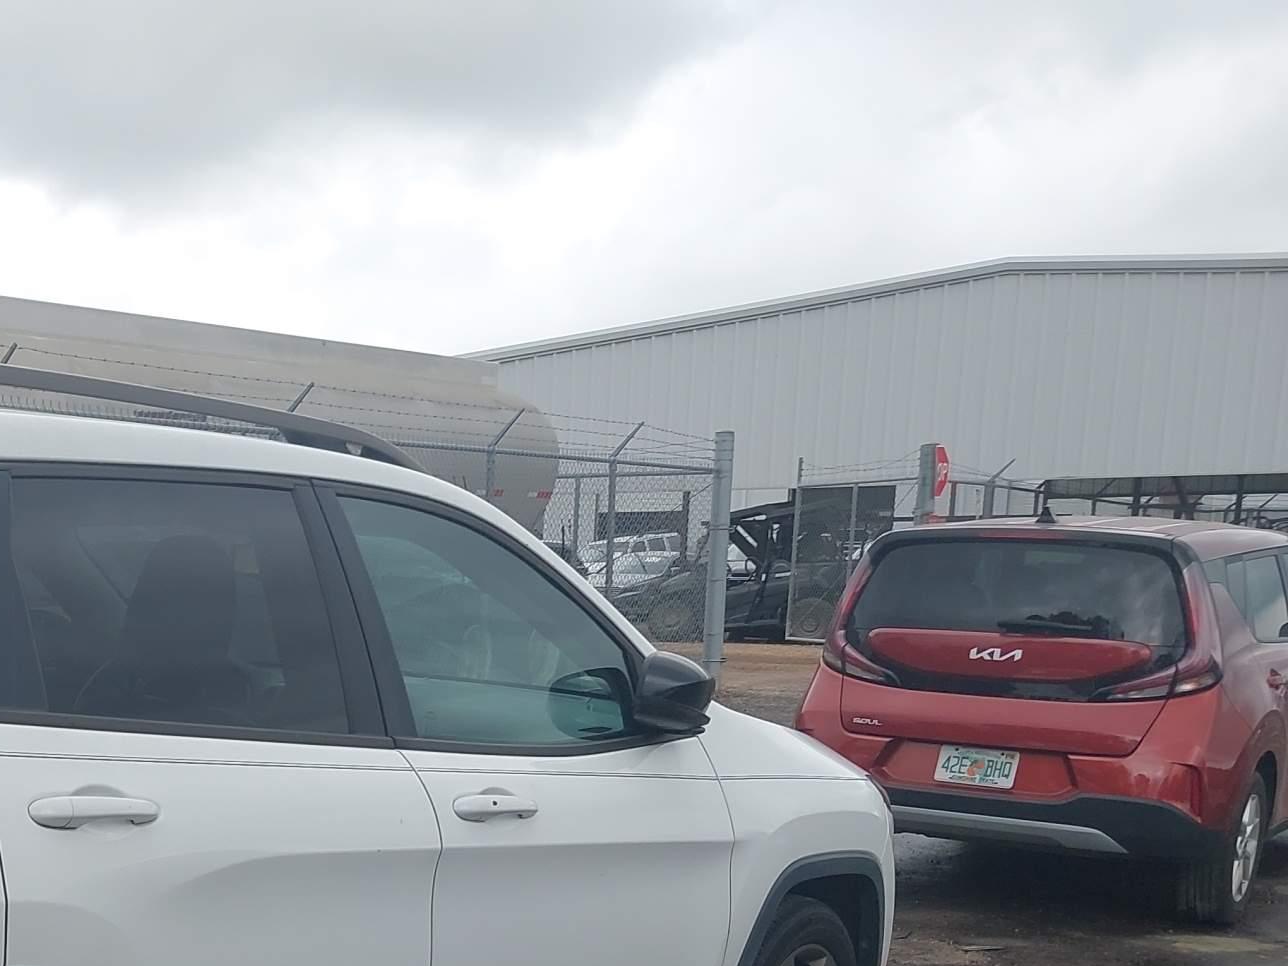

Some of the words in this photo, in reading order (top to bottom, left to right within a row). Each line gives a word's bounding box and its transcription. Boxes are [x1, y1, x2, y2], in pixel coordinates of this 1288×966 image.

[969, 648, 1023, 661] KIA
[853, 717, 883, 726] SOUL
[941, 755, 969, 775] 42E
